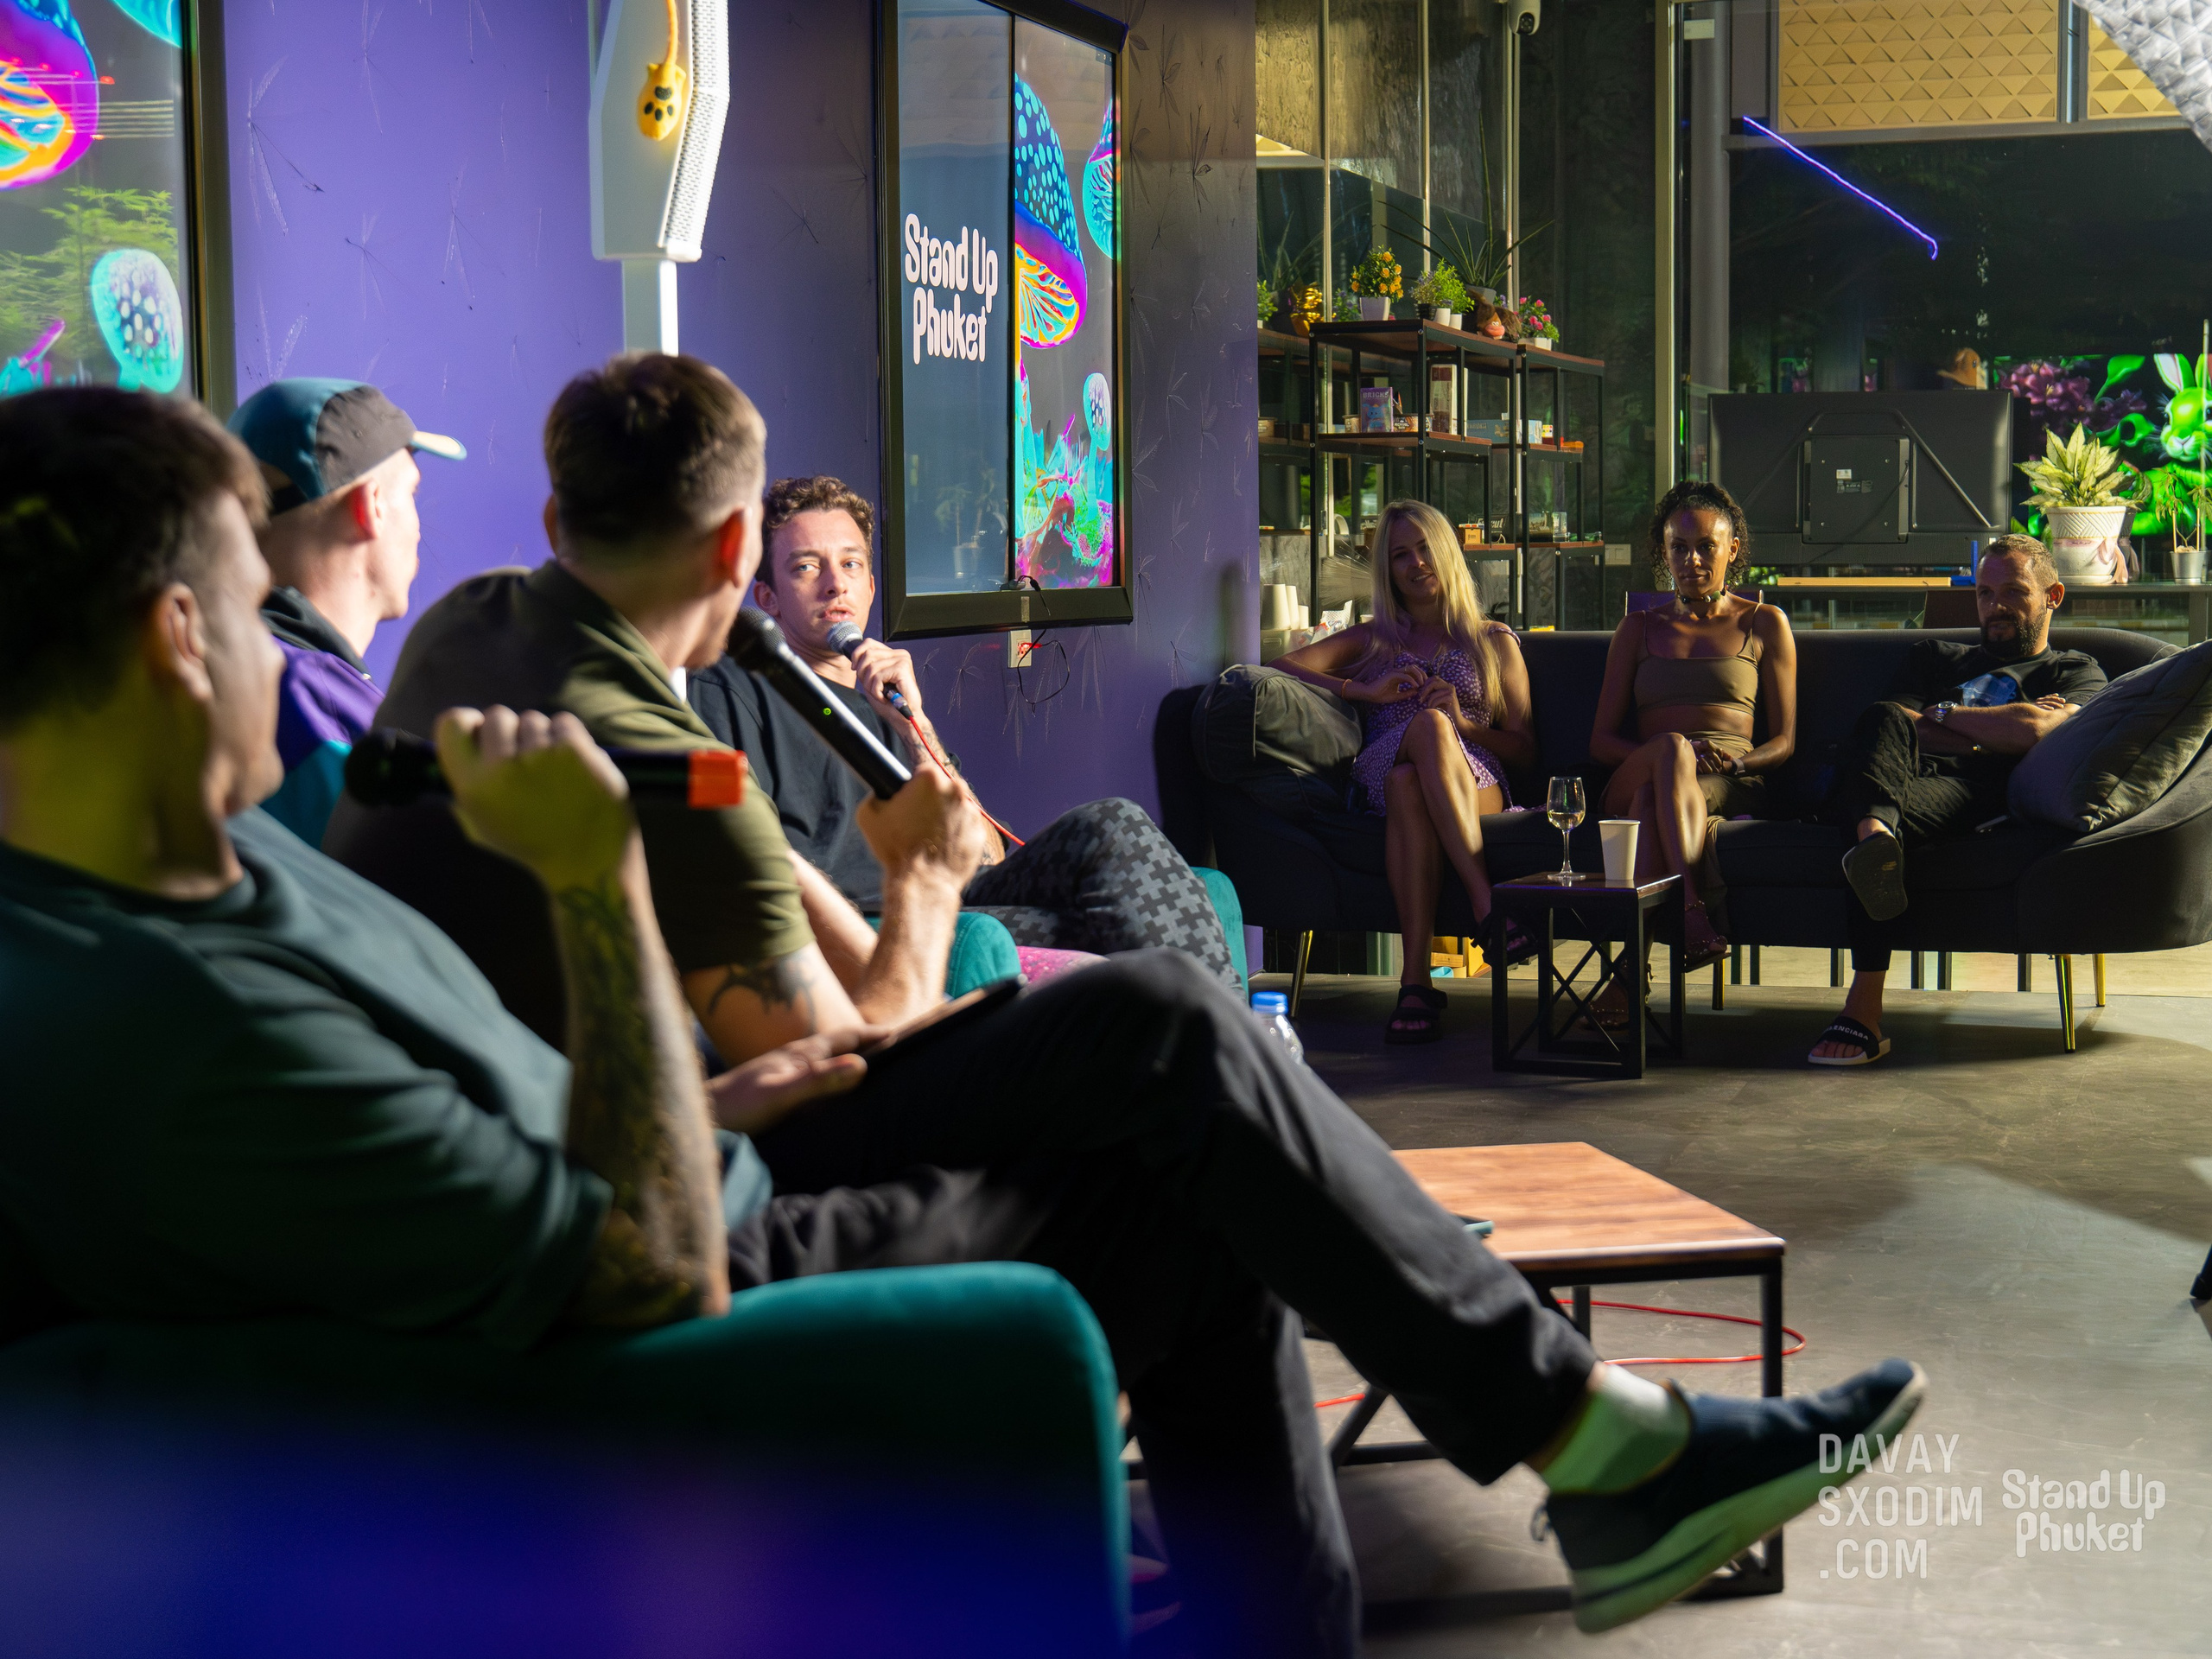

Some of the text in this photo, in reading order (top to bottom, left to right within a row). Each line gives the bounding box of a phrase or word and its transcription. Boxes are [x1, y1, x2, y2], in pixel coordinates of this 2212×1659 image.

[905, 213, 998, 313] Stand Up
[913, 287, 987, 365] Phuket
